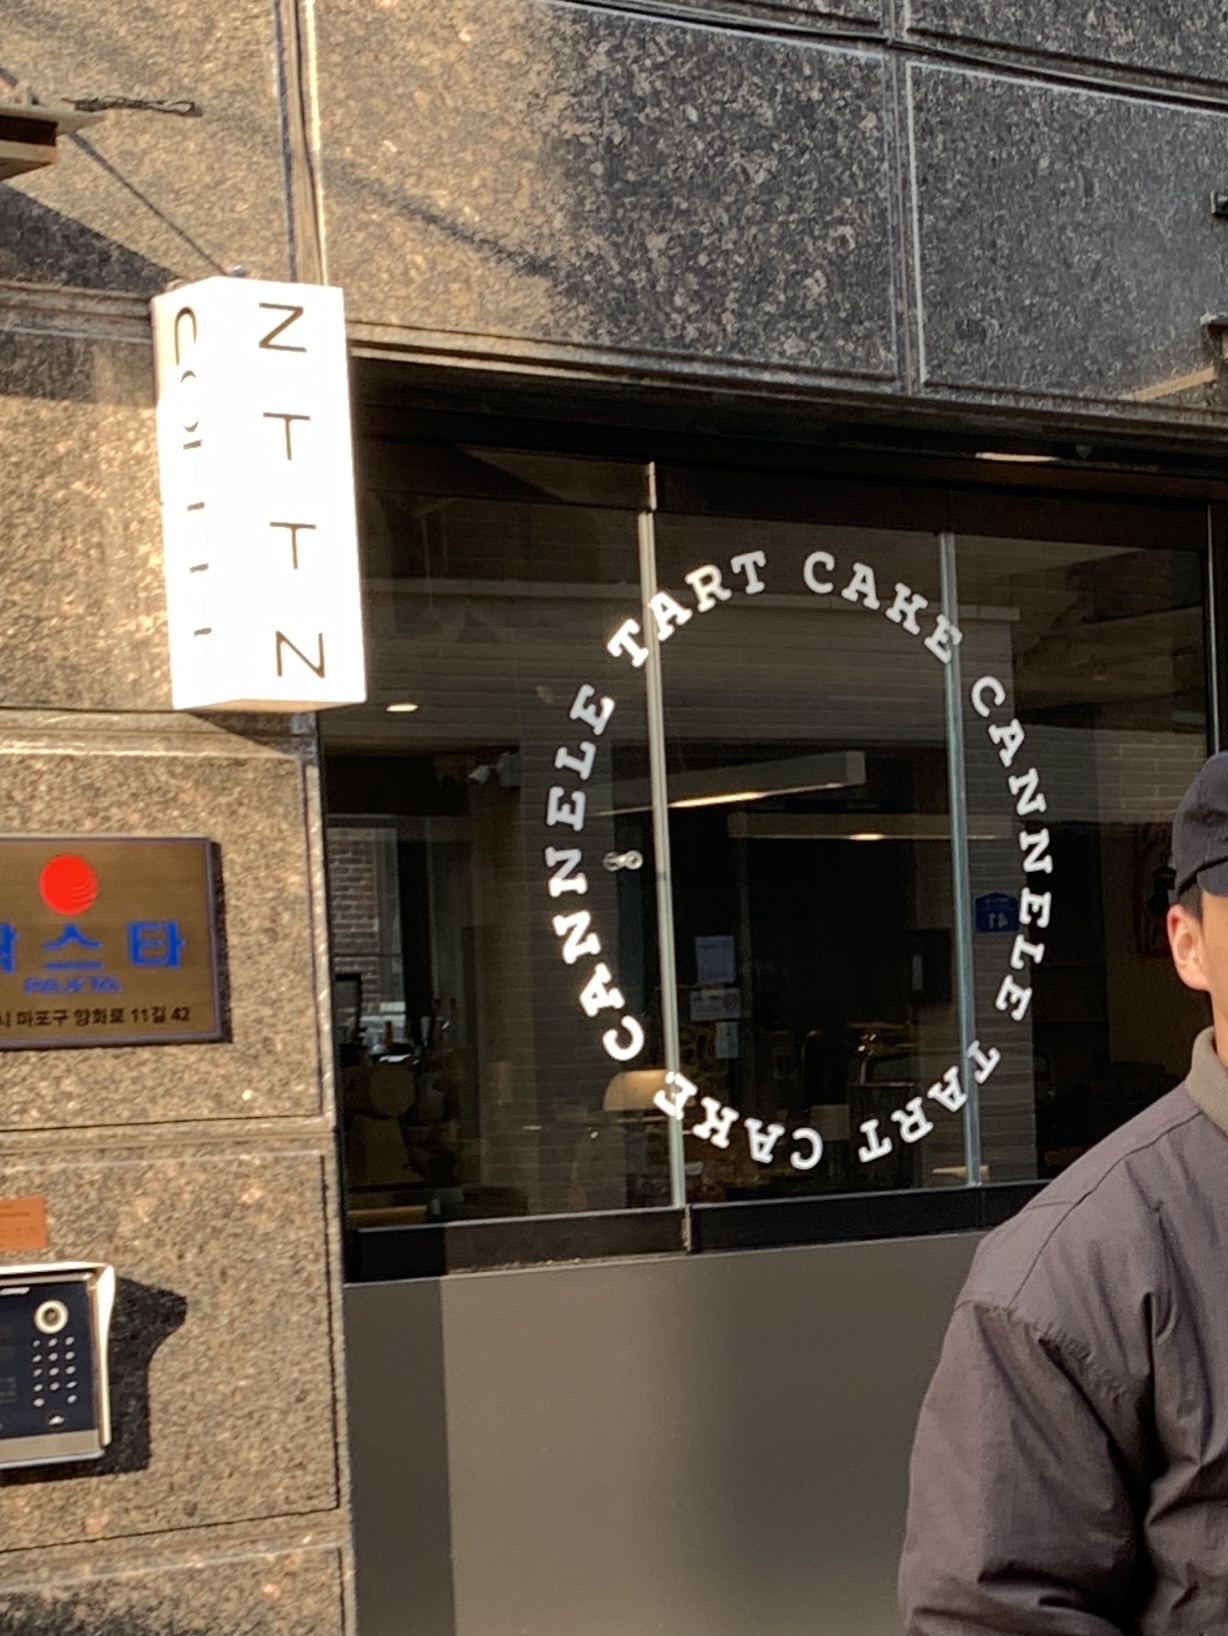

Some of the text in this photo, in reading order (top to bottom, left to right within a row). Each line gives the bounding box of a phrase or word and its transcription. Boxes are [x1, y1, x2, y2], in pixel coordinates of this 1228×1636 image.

[171, 1006, 191, 1022] 42
[545, 551, 1054, 1170] TART CAKE CANNELE TART CAKE CANNELE
